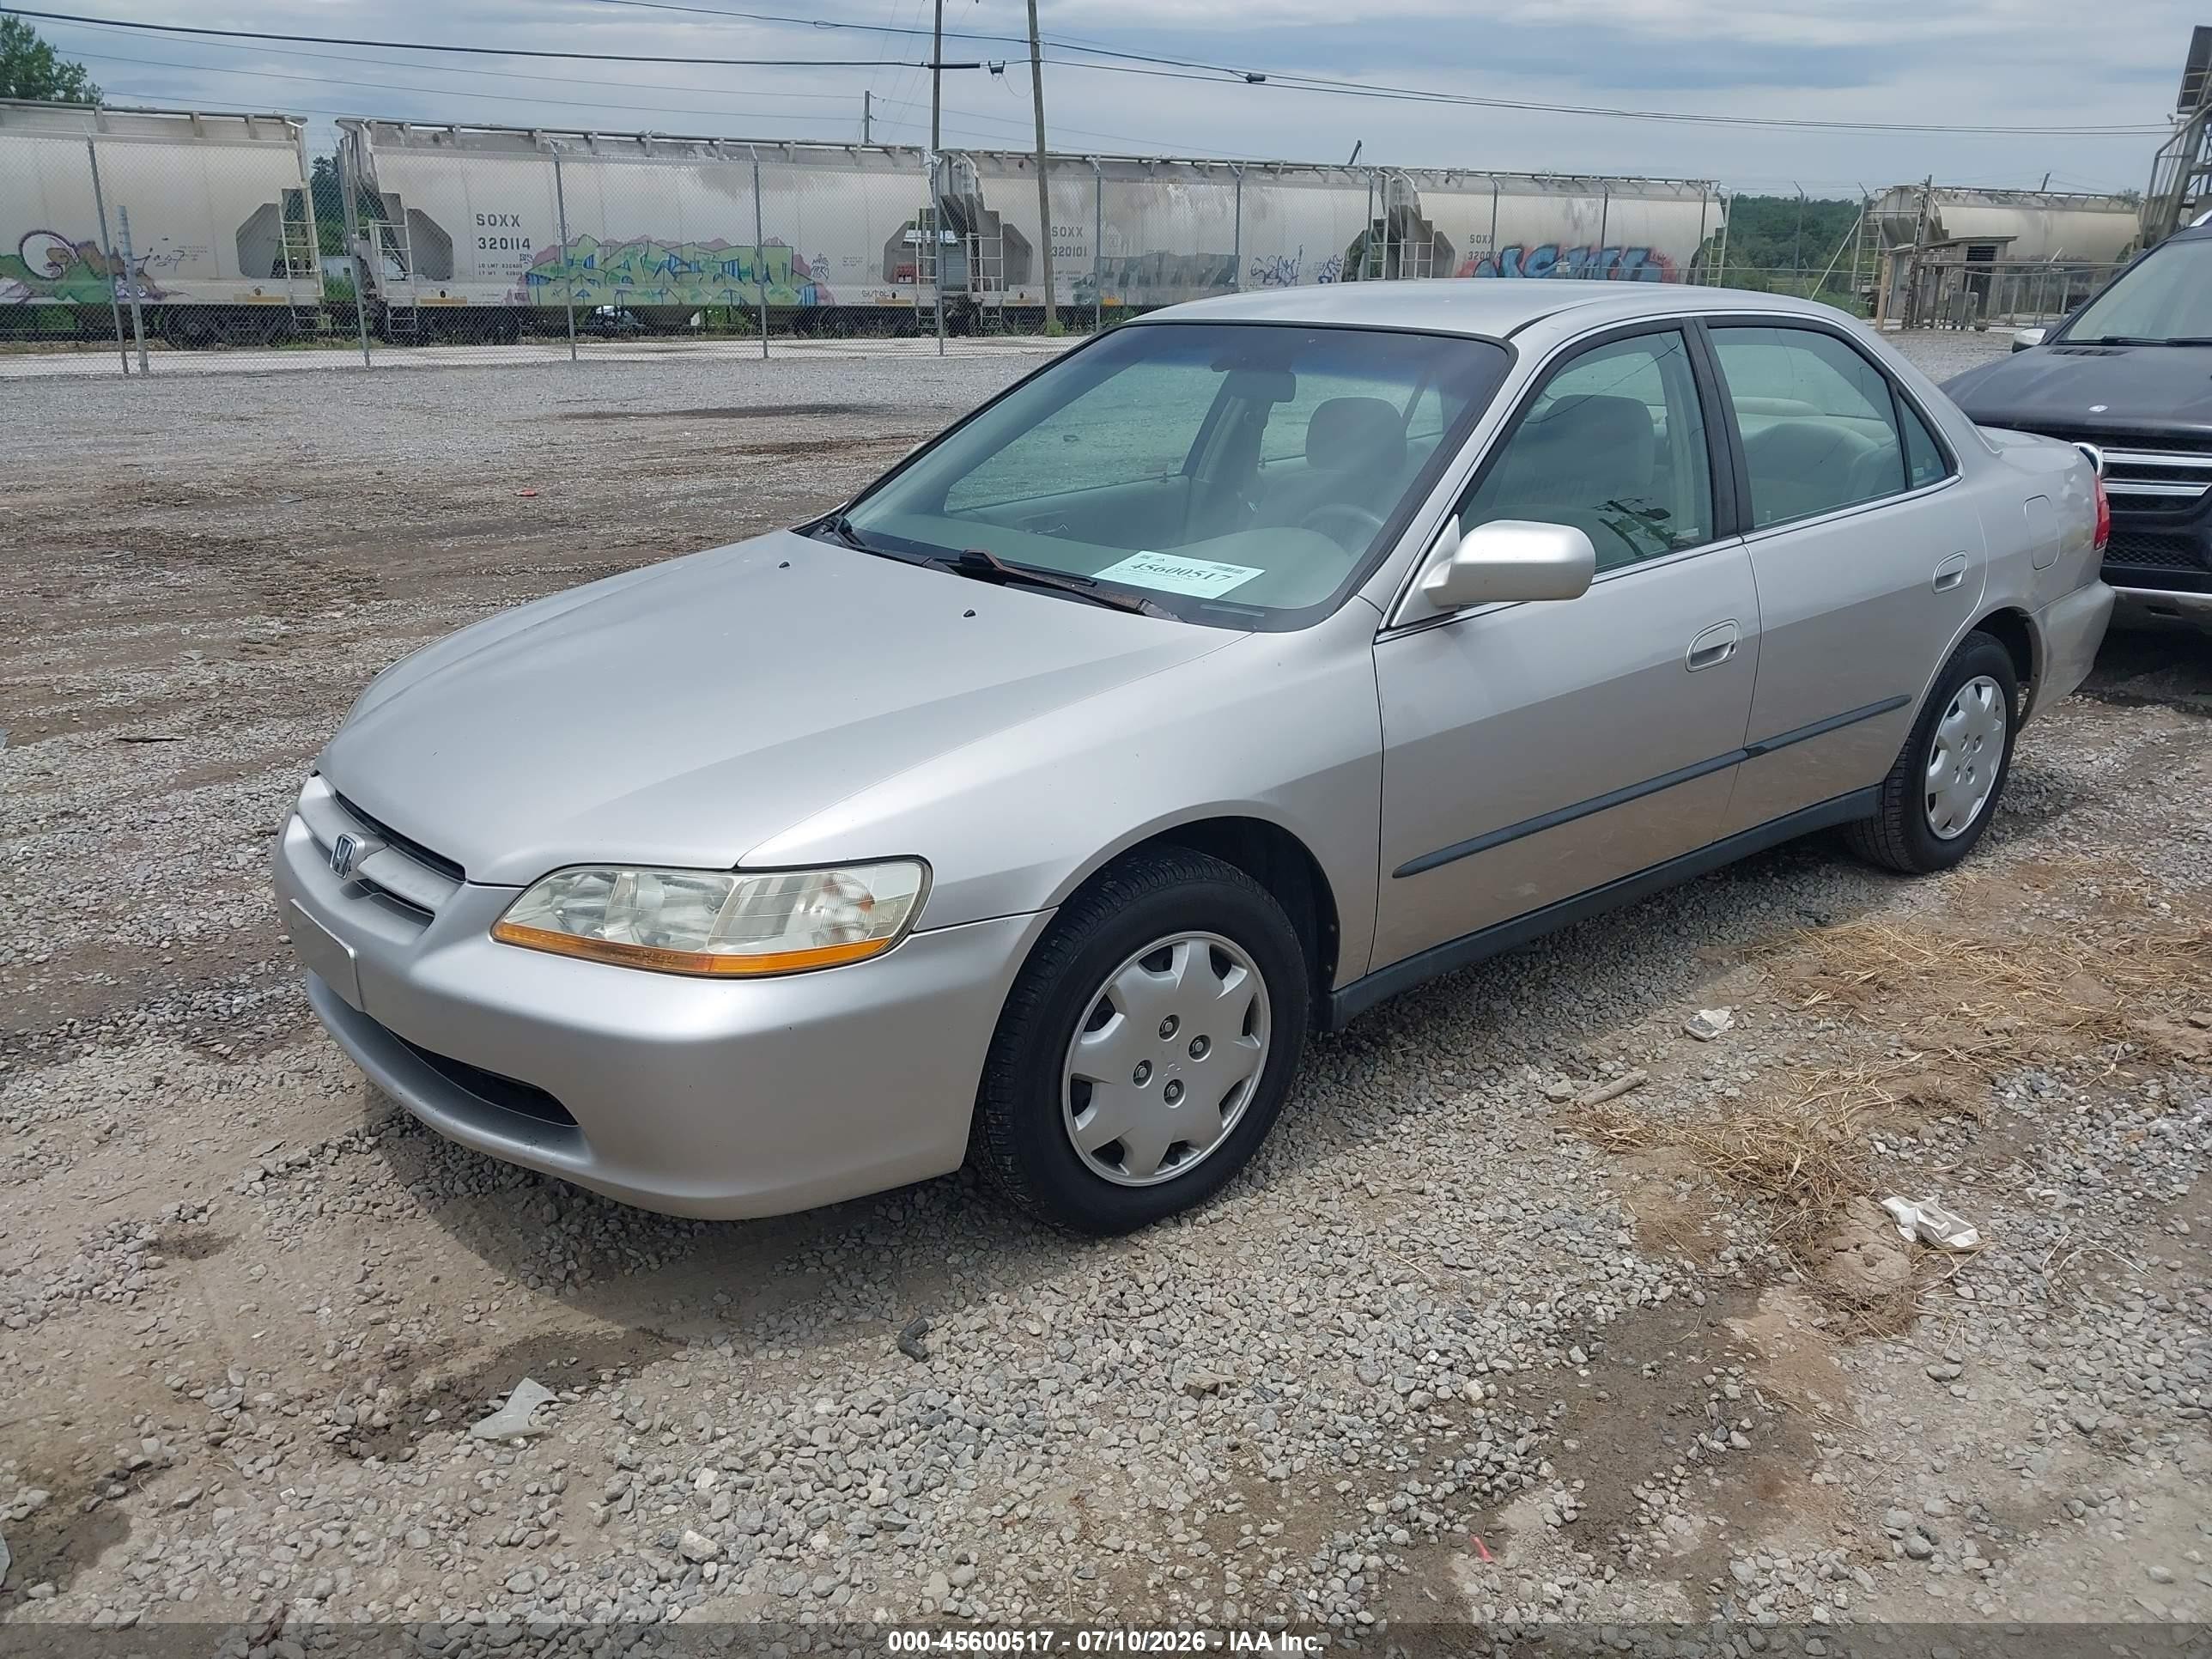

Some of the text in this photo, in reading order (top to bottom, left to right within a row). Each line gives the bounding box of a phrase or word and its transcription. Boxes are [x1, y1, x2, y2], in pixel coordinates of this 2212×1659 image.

[476, 213, 520, 228] SOXX
[1051, 226, 1083, 237] SOXX
[477, 237, 531, 250] 320114
[1051, 246, 1088, 258] 320101
[1130, 562, 1233, 583] 45600517
